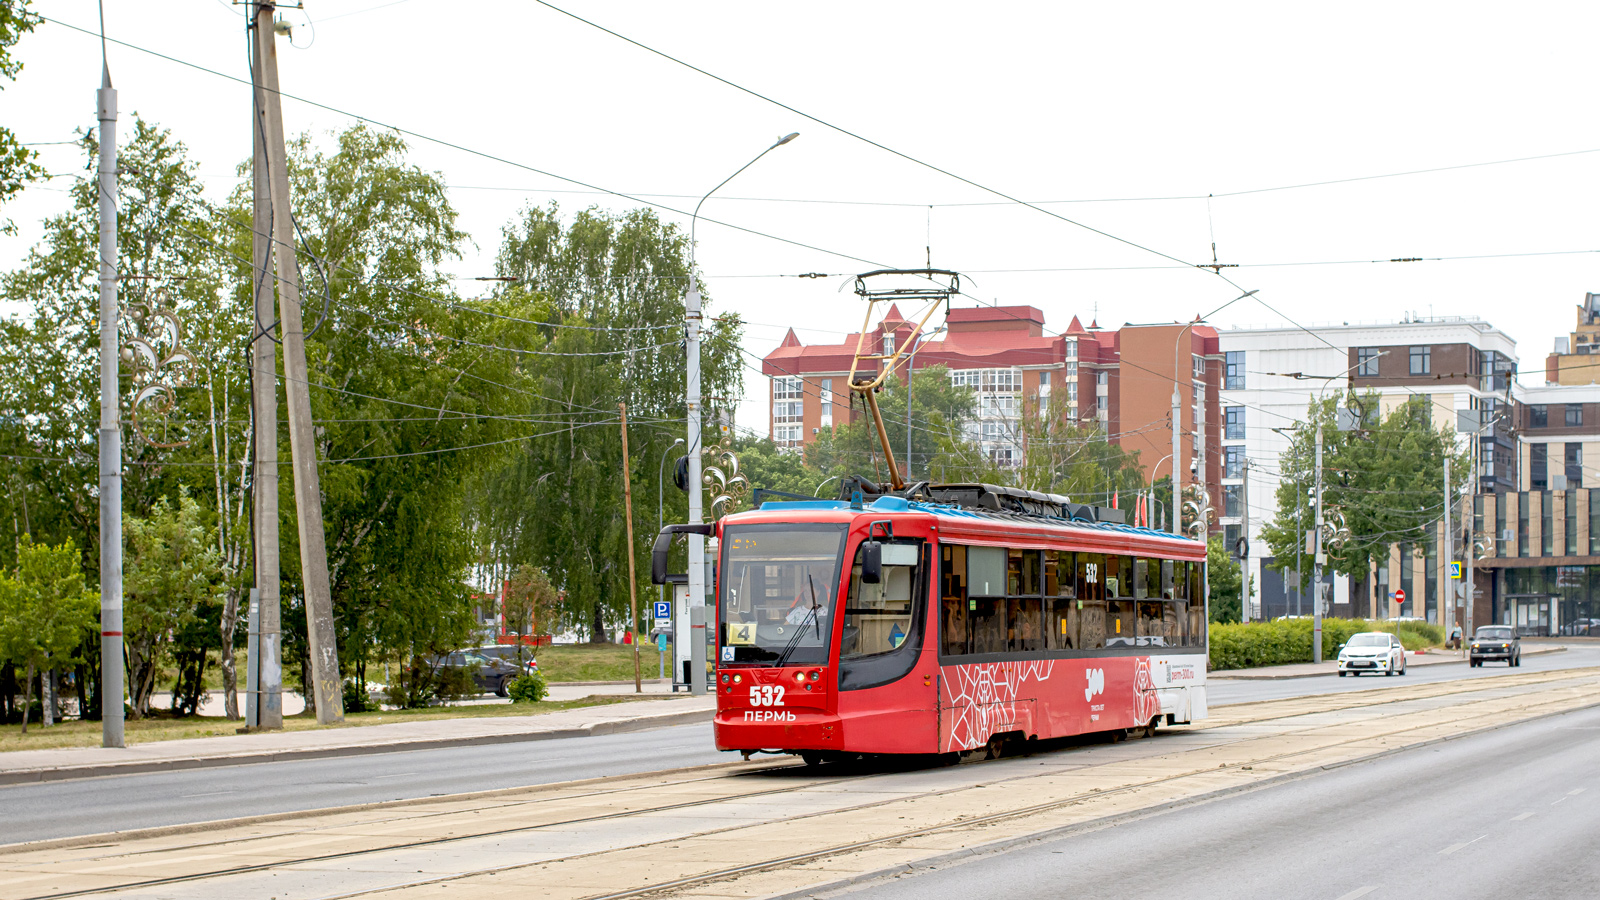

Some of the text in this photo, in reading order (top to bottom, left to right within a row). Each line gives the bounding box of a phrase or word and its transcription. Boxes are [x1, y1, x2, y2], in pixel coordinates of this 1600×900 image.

[1086, 563, 1098, 583] 532
[737, 625, 750, 641] 4
[749, 685, 785, 707] 532
[744, 710, 797, 722] ПЕРМЬ
